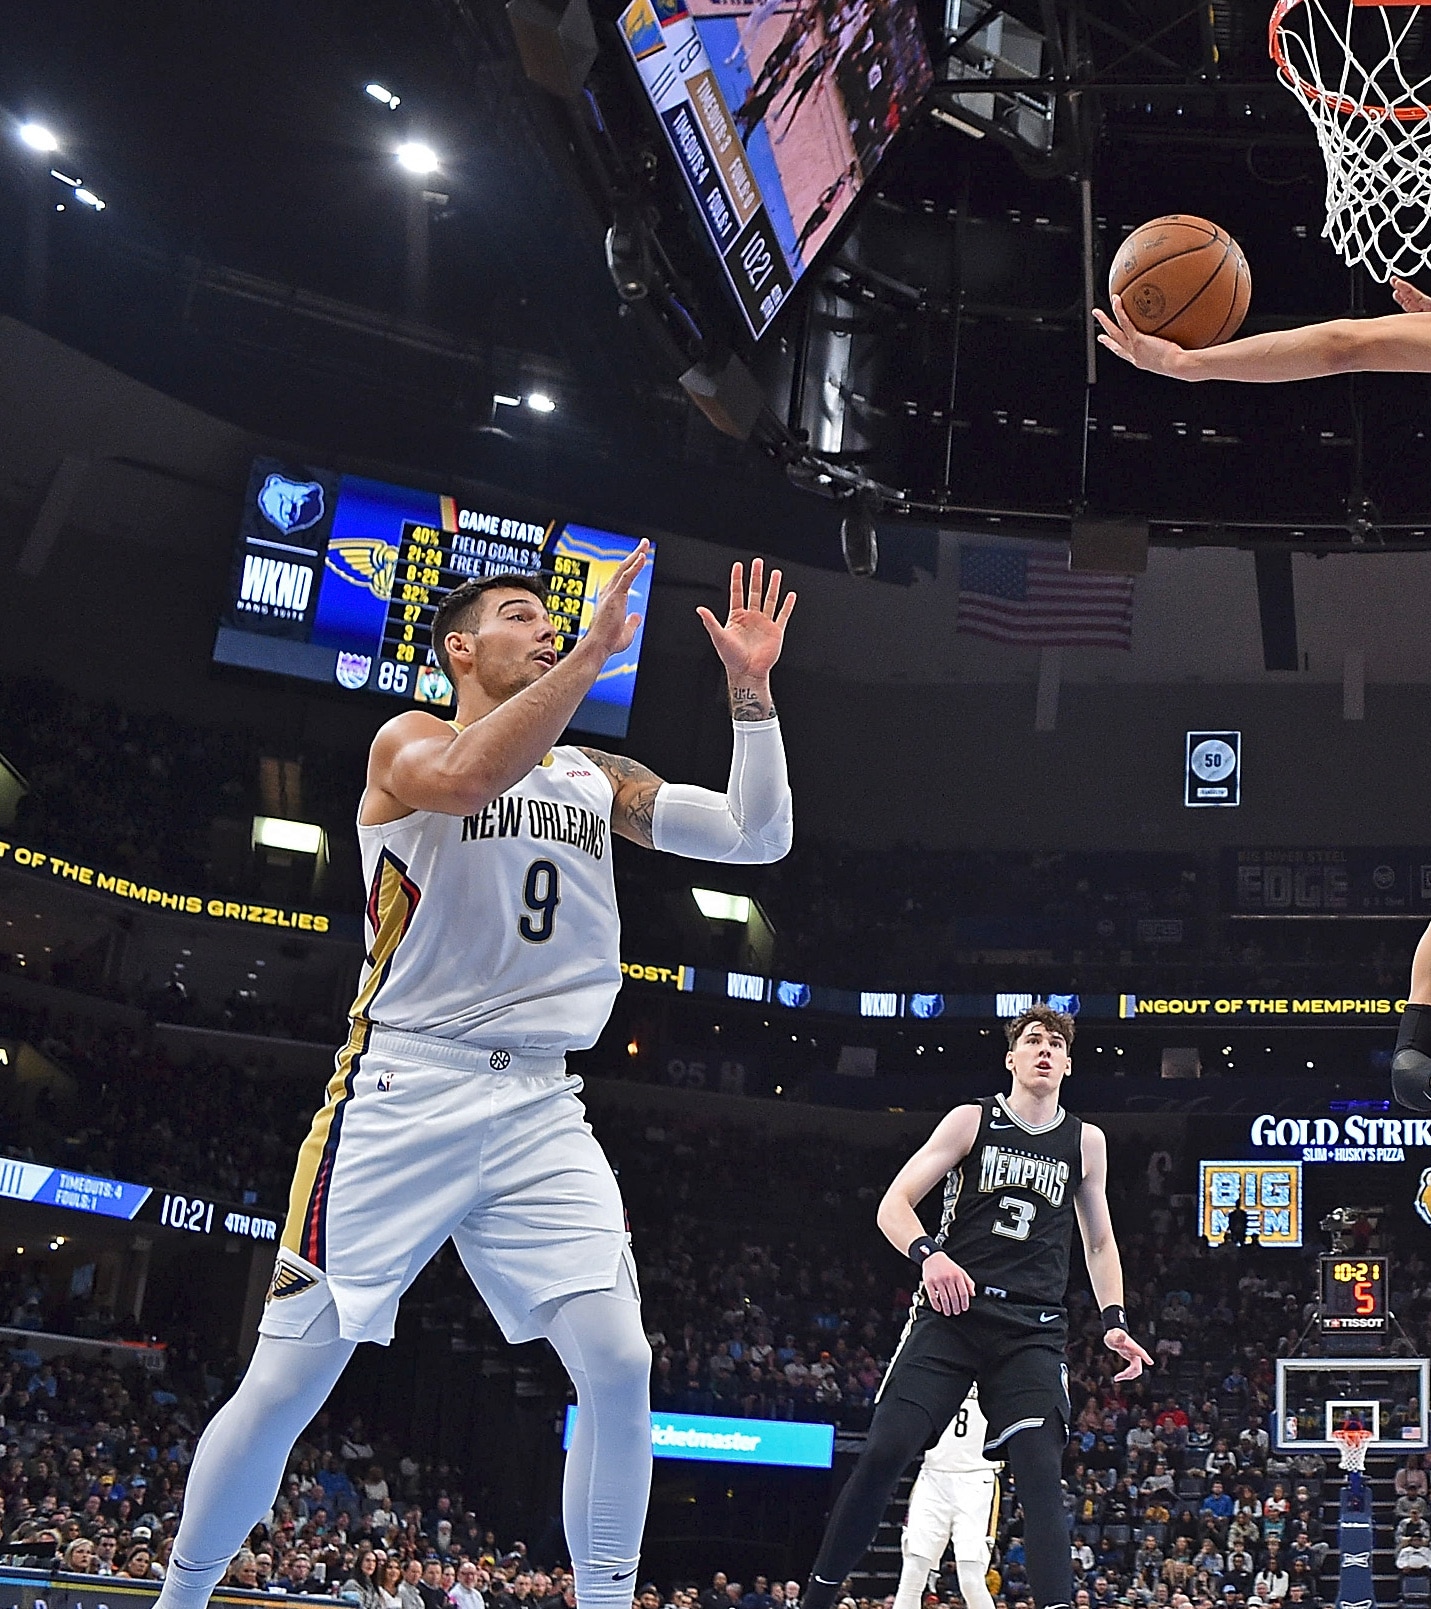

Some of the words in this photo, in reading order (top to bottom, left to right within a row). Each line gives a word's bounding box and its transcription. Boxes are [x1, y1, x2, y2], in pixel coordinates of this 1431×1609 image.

[458, 509, 499, 536] GAME
[500, 516, 545, 545] STATS
[412, 526, 440, 547] 40%
[451, 534, 487, 556] FIELD
[488, 542, 529, 565] GOALS
[450, 553, 481, 577] FREE
[241, 554, 313, 611] WKND
[402, 584, 429, 604] 32%
[403, 605, 421, 623] 27
[403, 625, 414, 642] 3
[378, 665, 409, 693] 85
[1205, 754, 1222, 767] 50
[527, 799, 606, 860] ORLEANS
[14, 847, 47, 868] OF
[50, 857, 94, 885] THE
[97, 872, 202, 914] MEMPHIS
[207, 900, 329, 933] GRIZZLIES
[518, 858, 561, 944] 9
[727, 973, 764, 1001] WKND
[861, 992, 897, 1017] WKND
[1215, 1000, 1243, 1013] OF
[1247, 1000, 1288, 1013] THE
[1292, 1000, 1390, 1013] MEMPHIS
[1251, 1114, 1339, 1146] GOLD
[1303, 1148, 1327, 1162] SLIM
[1334, 1148, 1376, 1162] HUSKY'S
[1376, 1148, 1405, 1162] PIZZA
[978, 1145, 1070, 1208] MEMPHIS
[1210, 1172, 1291, 1207] BIG
[160, 1193, 215, 1234] 10:21
[225, 1212, 249, 1234] 4TH
[250, 1218, 277, 1241] QTR
[992, 1196, 1037, 1241] 3
[1333, 1262, 1380, 1282] 10:21
[1354, 1281, 1375, 1314] 5
[1340, 1318, 1384, 1328] TISSOT
[955, 1407, 968, 1438] 8
[652, 1424, 761, 1453] icketmaster
